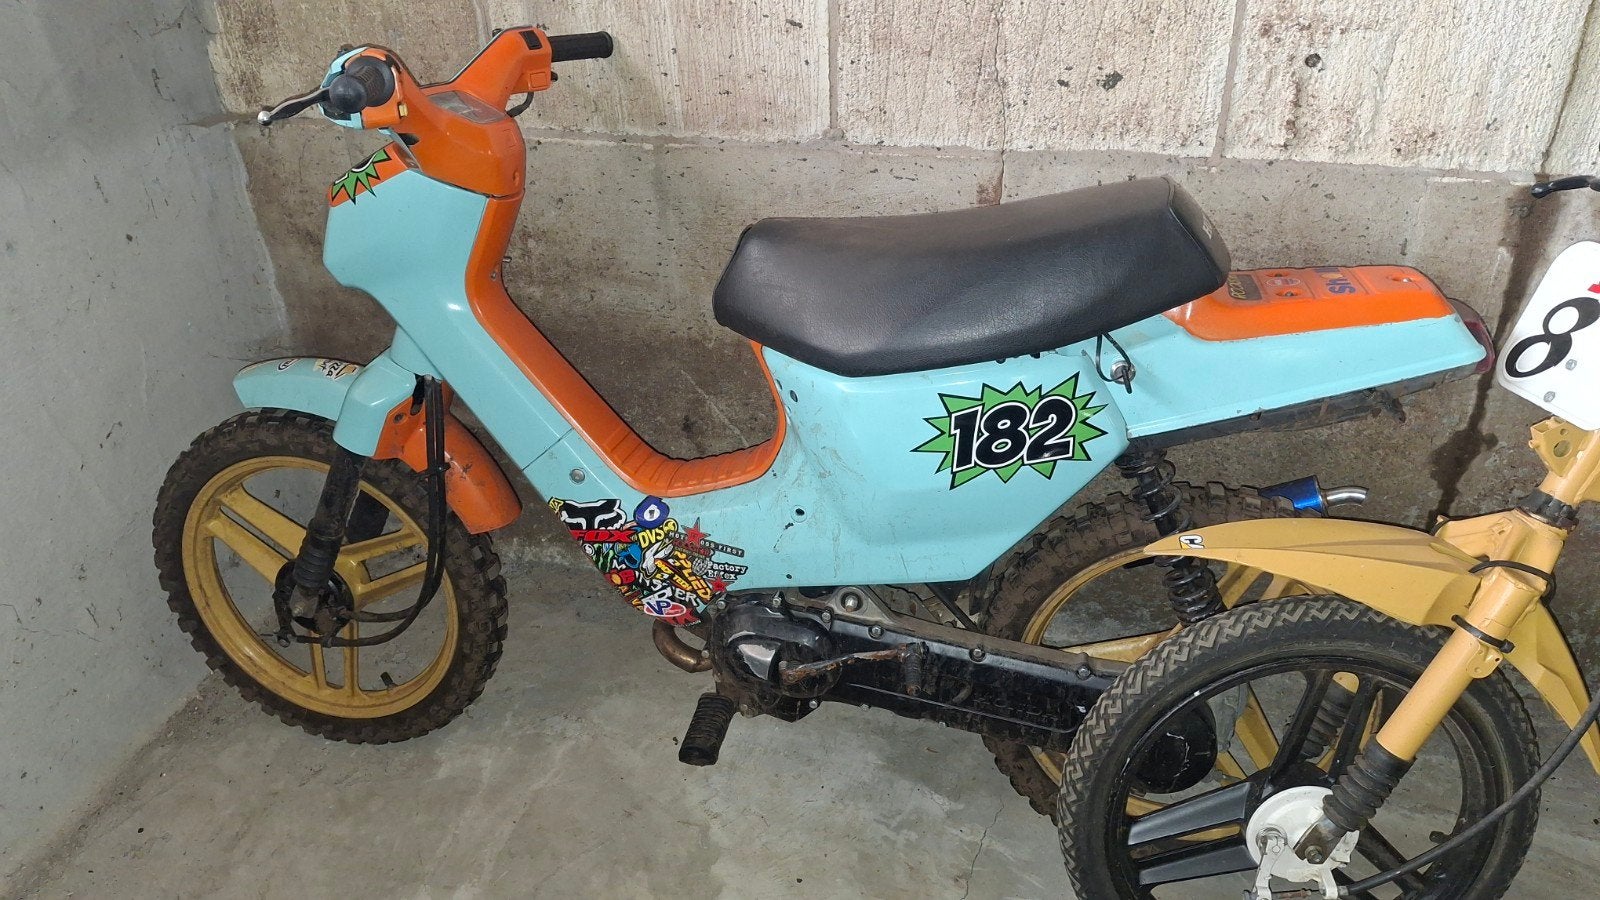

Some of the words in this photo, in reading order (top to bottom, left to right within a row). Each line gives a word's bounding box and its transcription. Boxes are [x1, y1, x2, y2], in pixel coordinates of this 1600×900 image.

[950, 395, 1077, 473] 182
[569, 529, 637, 543] FOX
[638, 528, 665, 549] DVS
[706, 560, 748, 574] Factory
[645, 600, 672, 616] VP
